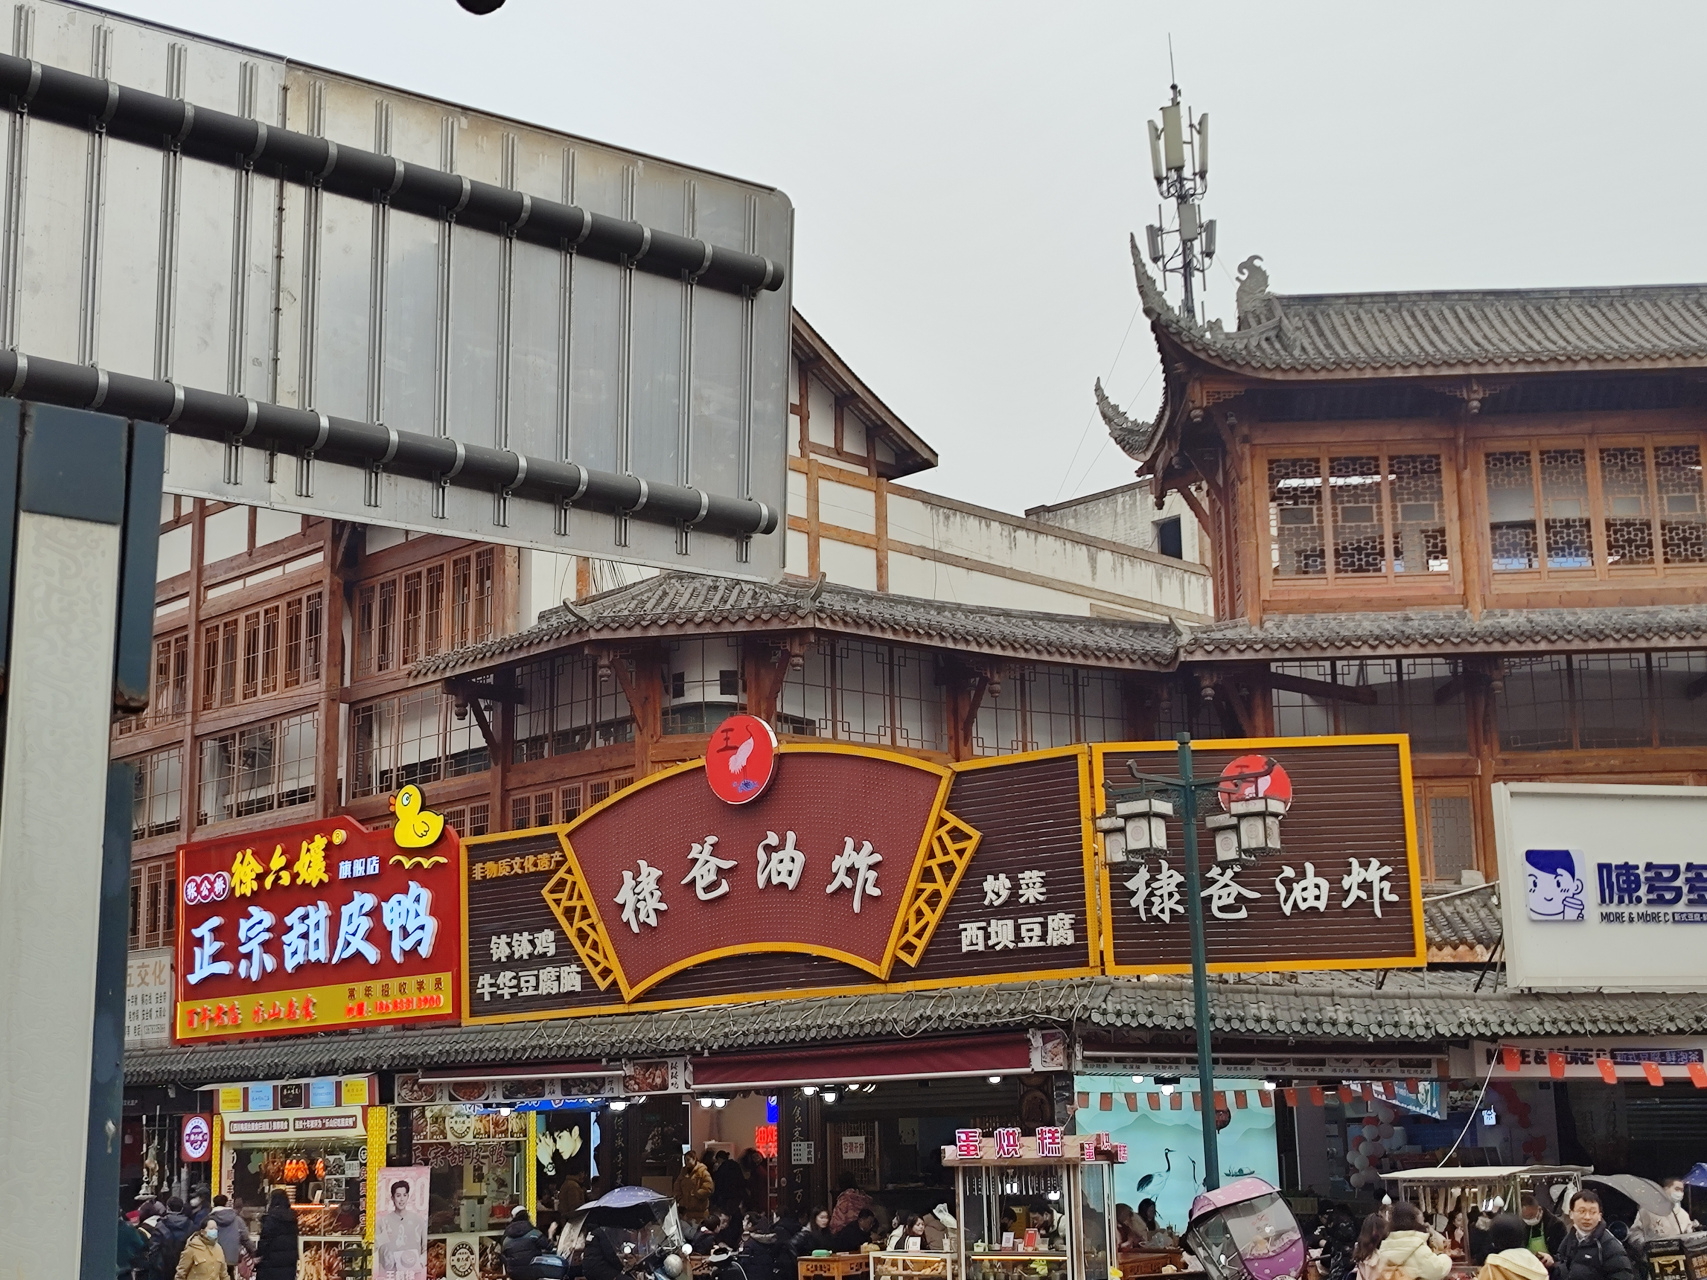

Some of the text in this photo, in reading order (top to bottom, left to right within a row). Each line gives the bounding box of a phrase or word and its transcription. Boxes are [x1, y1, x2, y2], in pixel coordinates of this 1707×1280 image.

[338, 856, 380, 880] 旗舰店
[472, 851, 565, 880] 非物质文化遗产
[613, 830, 882, 933] 棣爸油炸
[186, 876, 228, 900] 张公桥
[983, 870, 1047, 906] 炒菜
[1123, 857, 1400, 924] 棣爸油炸
[186, 881, 438, 986] 正宗甜皮鸭
[959, 912, 1077, 953] 西坝豆腐
[1600, 911, 1626, 923] MORE
[1628, 911, 1636, 923] &
[490, 928, 556, 962] 钵钵鸡
[347, 977, 444, 1001] 常年招收学员
[476, 964, 582, 1001] 牛华豆腐脑
[955, 1126, 1064, 1159] 蛋烘糕
